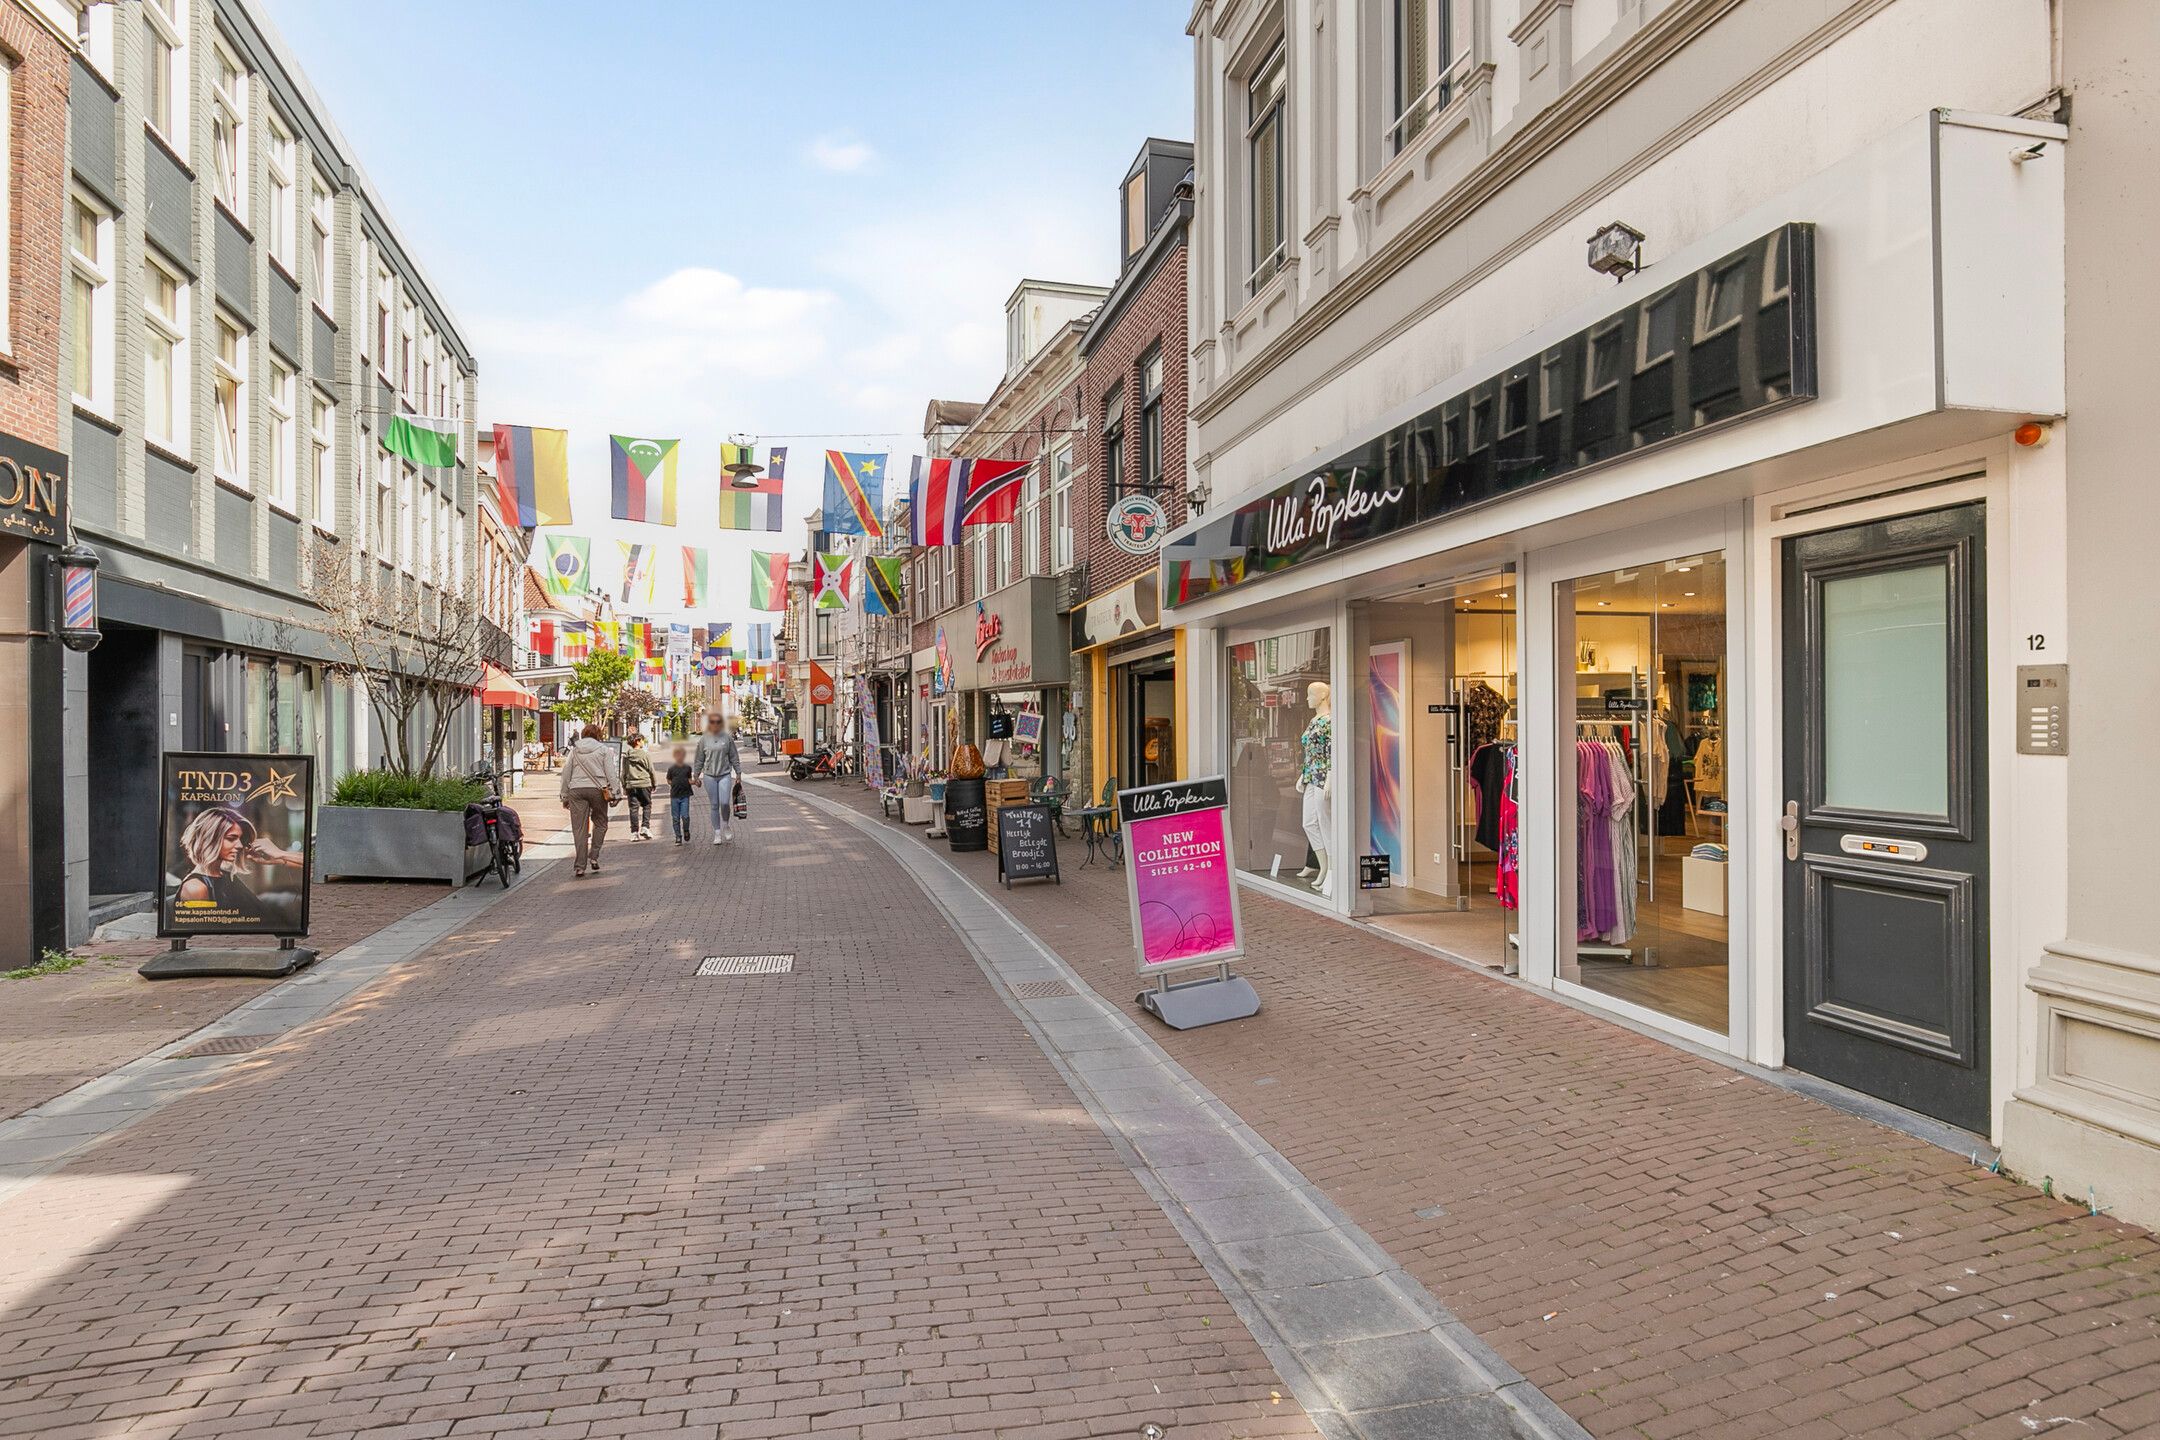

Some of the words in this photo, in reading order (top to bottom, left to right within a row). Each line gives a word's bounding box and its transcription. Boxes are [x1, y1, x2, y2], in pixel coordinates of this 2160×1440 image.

[1267, 496, 1306, 553] Ulla
[1307, 467, 1404, 550] Popken
[2027, 634, 2045, 651] 12
[178, 770, 252, 792] TND3
[181, 792, 241, 801] KAPSALON
[1133, 794, 1161, 813] Ulla
[1162, 788, 1214, 812] Popken
[1163, 831, 1193, 845] NEW
[1138, 841, 1220, 862] COLLECTION
[1151, 865, 1179, 876] SIZES
[1183, 860, 1212, 872] 42-60
[175, 908, 239, 916] www.kapsalontnd.nl
[175, 916, 261, 924] kapsalonTND3@gmail.com
